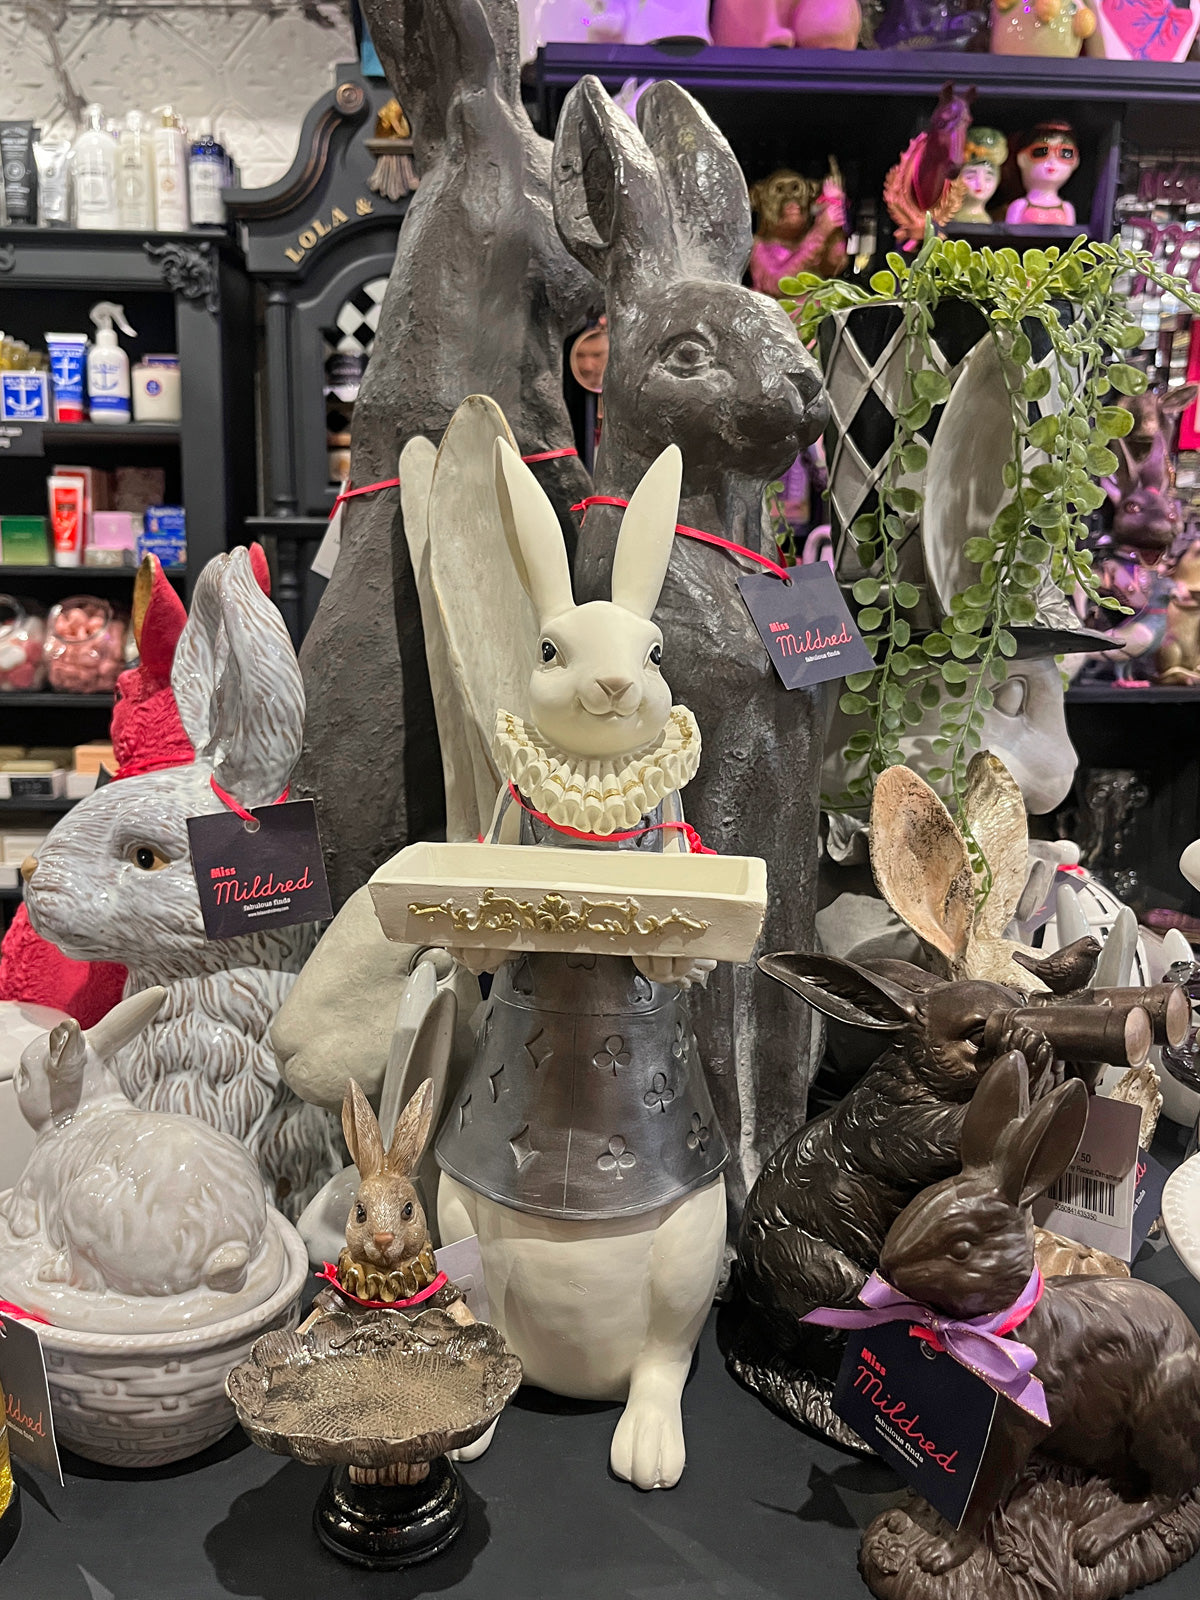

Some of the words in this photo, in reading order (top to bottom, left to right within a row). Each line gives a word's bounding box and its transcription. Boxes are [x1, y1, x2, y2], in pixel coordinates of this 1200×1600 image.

[284, 206, 349, 264] LOLA
[355, 197, 374, 216] &
[769, 621, 790, 633] Miss
[775, 622, 853, 657] Mildred
[210, 866, 237, 879] Miss
[213, 866, 314, 905] Mildred
[243, 900, 273, 912] fabulous
[273, 897, 291, 907] finds
[860, 1347, 887, 1377] Miss
[5, 1393, 47, 1438] ldred
[853, 1365, 959, 1473] Mildred
[875, 1414, 904, 1445] fabulous
[904, 1442, 924, 1463] finds
